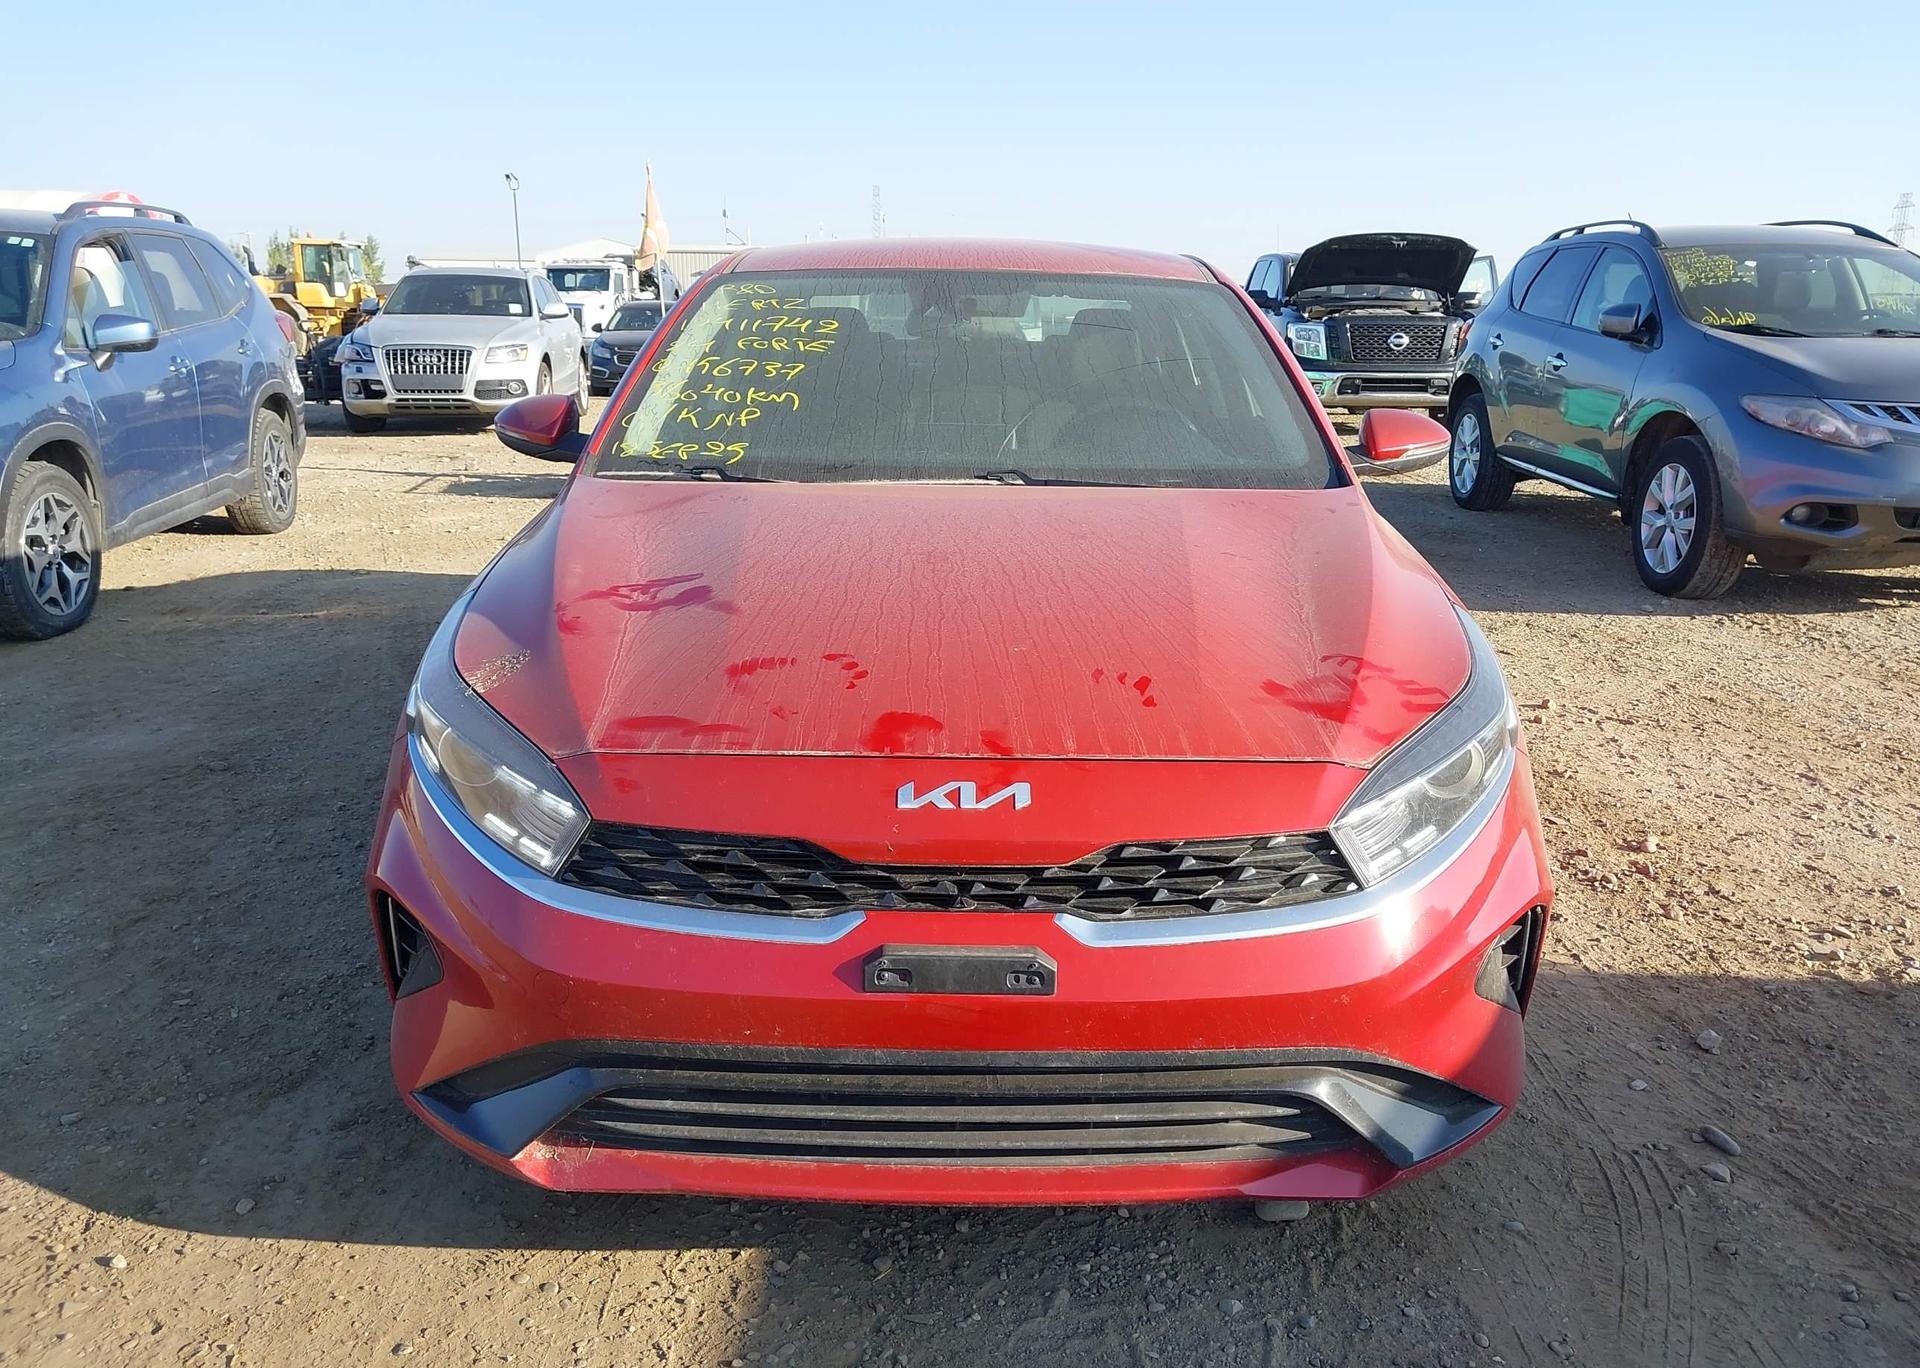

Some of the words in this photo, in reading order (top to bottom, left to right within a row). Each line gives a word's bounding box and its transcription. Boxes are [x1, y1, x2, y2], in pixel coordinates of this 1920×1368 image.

[704, 298, 809, 310] ERTZ
[737, 336, 836, 352] FORTE
[896, 780, 1032, 811] KIA
